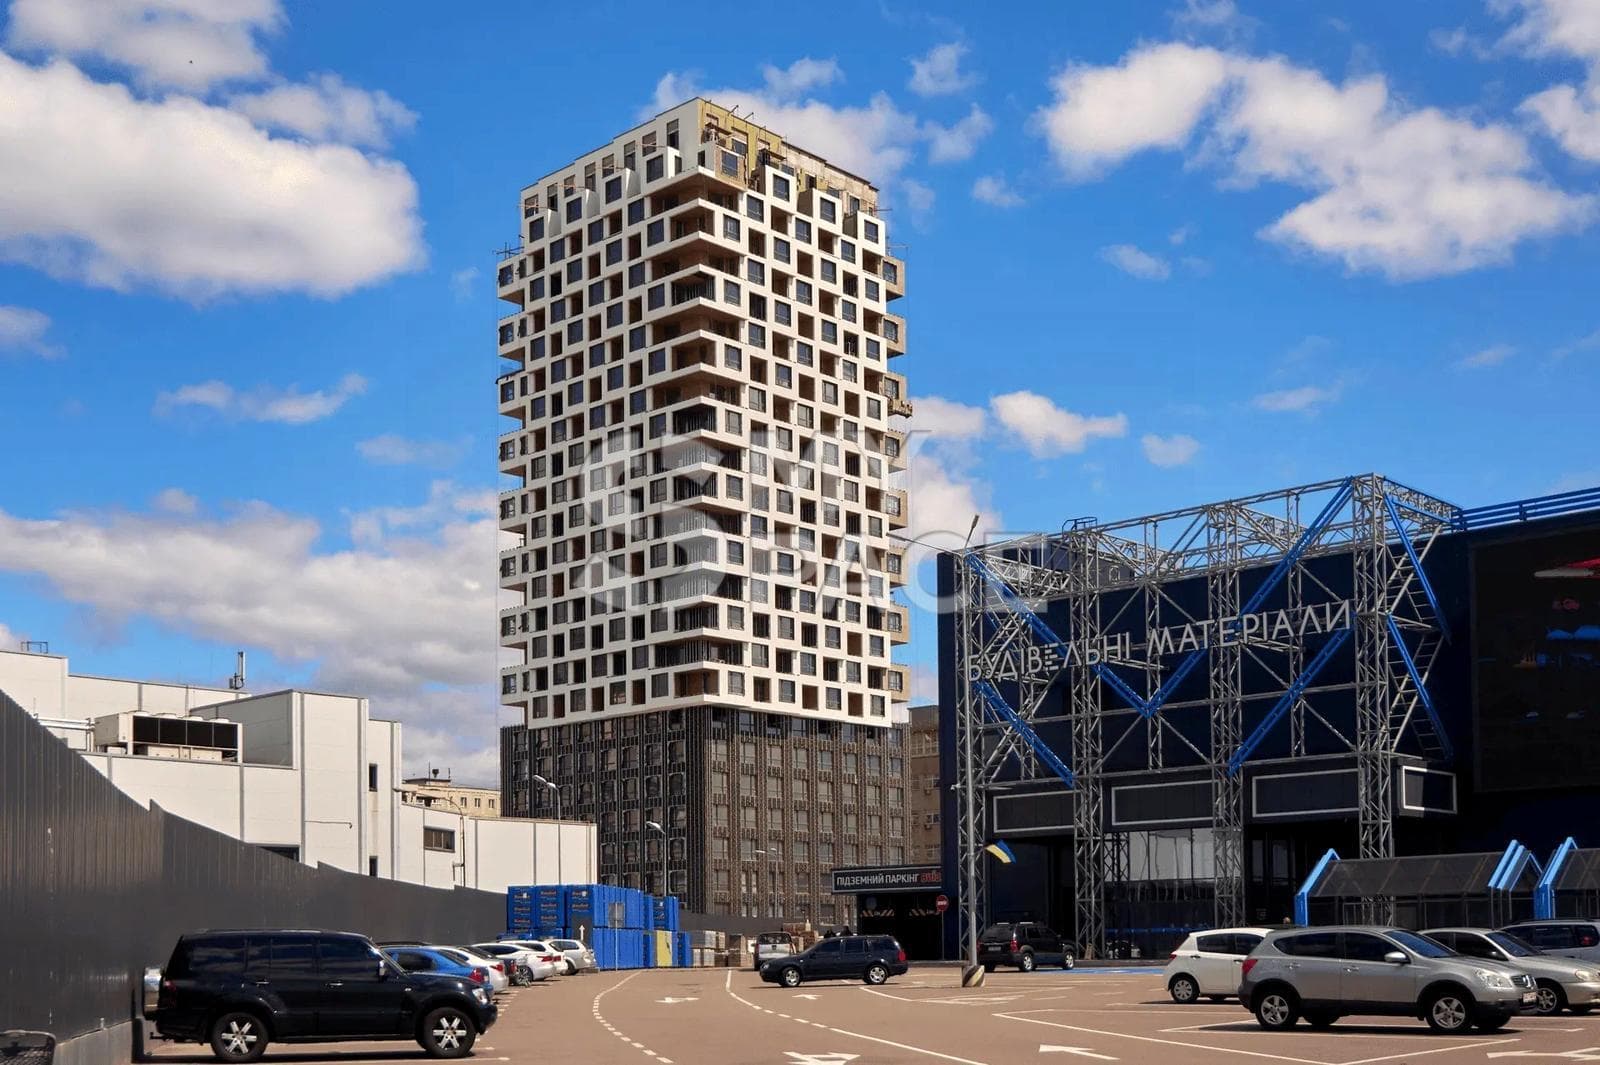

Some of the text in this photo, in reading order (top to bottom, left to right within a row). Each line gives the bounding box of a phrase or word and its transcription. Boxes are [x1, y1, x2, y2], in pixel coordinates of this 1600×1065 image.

[968, 600, 1350, 682] БУДІВЕЛЬНІ МАТЕРІАЛИ
[836, 871, 884, 886] ПІДЗЕМНИЙ
[885, 873, 919, 884] ПАРКІНГ
